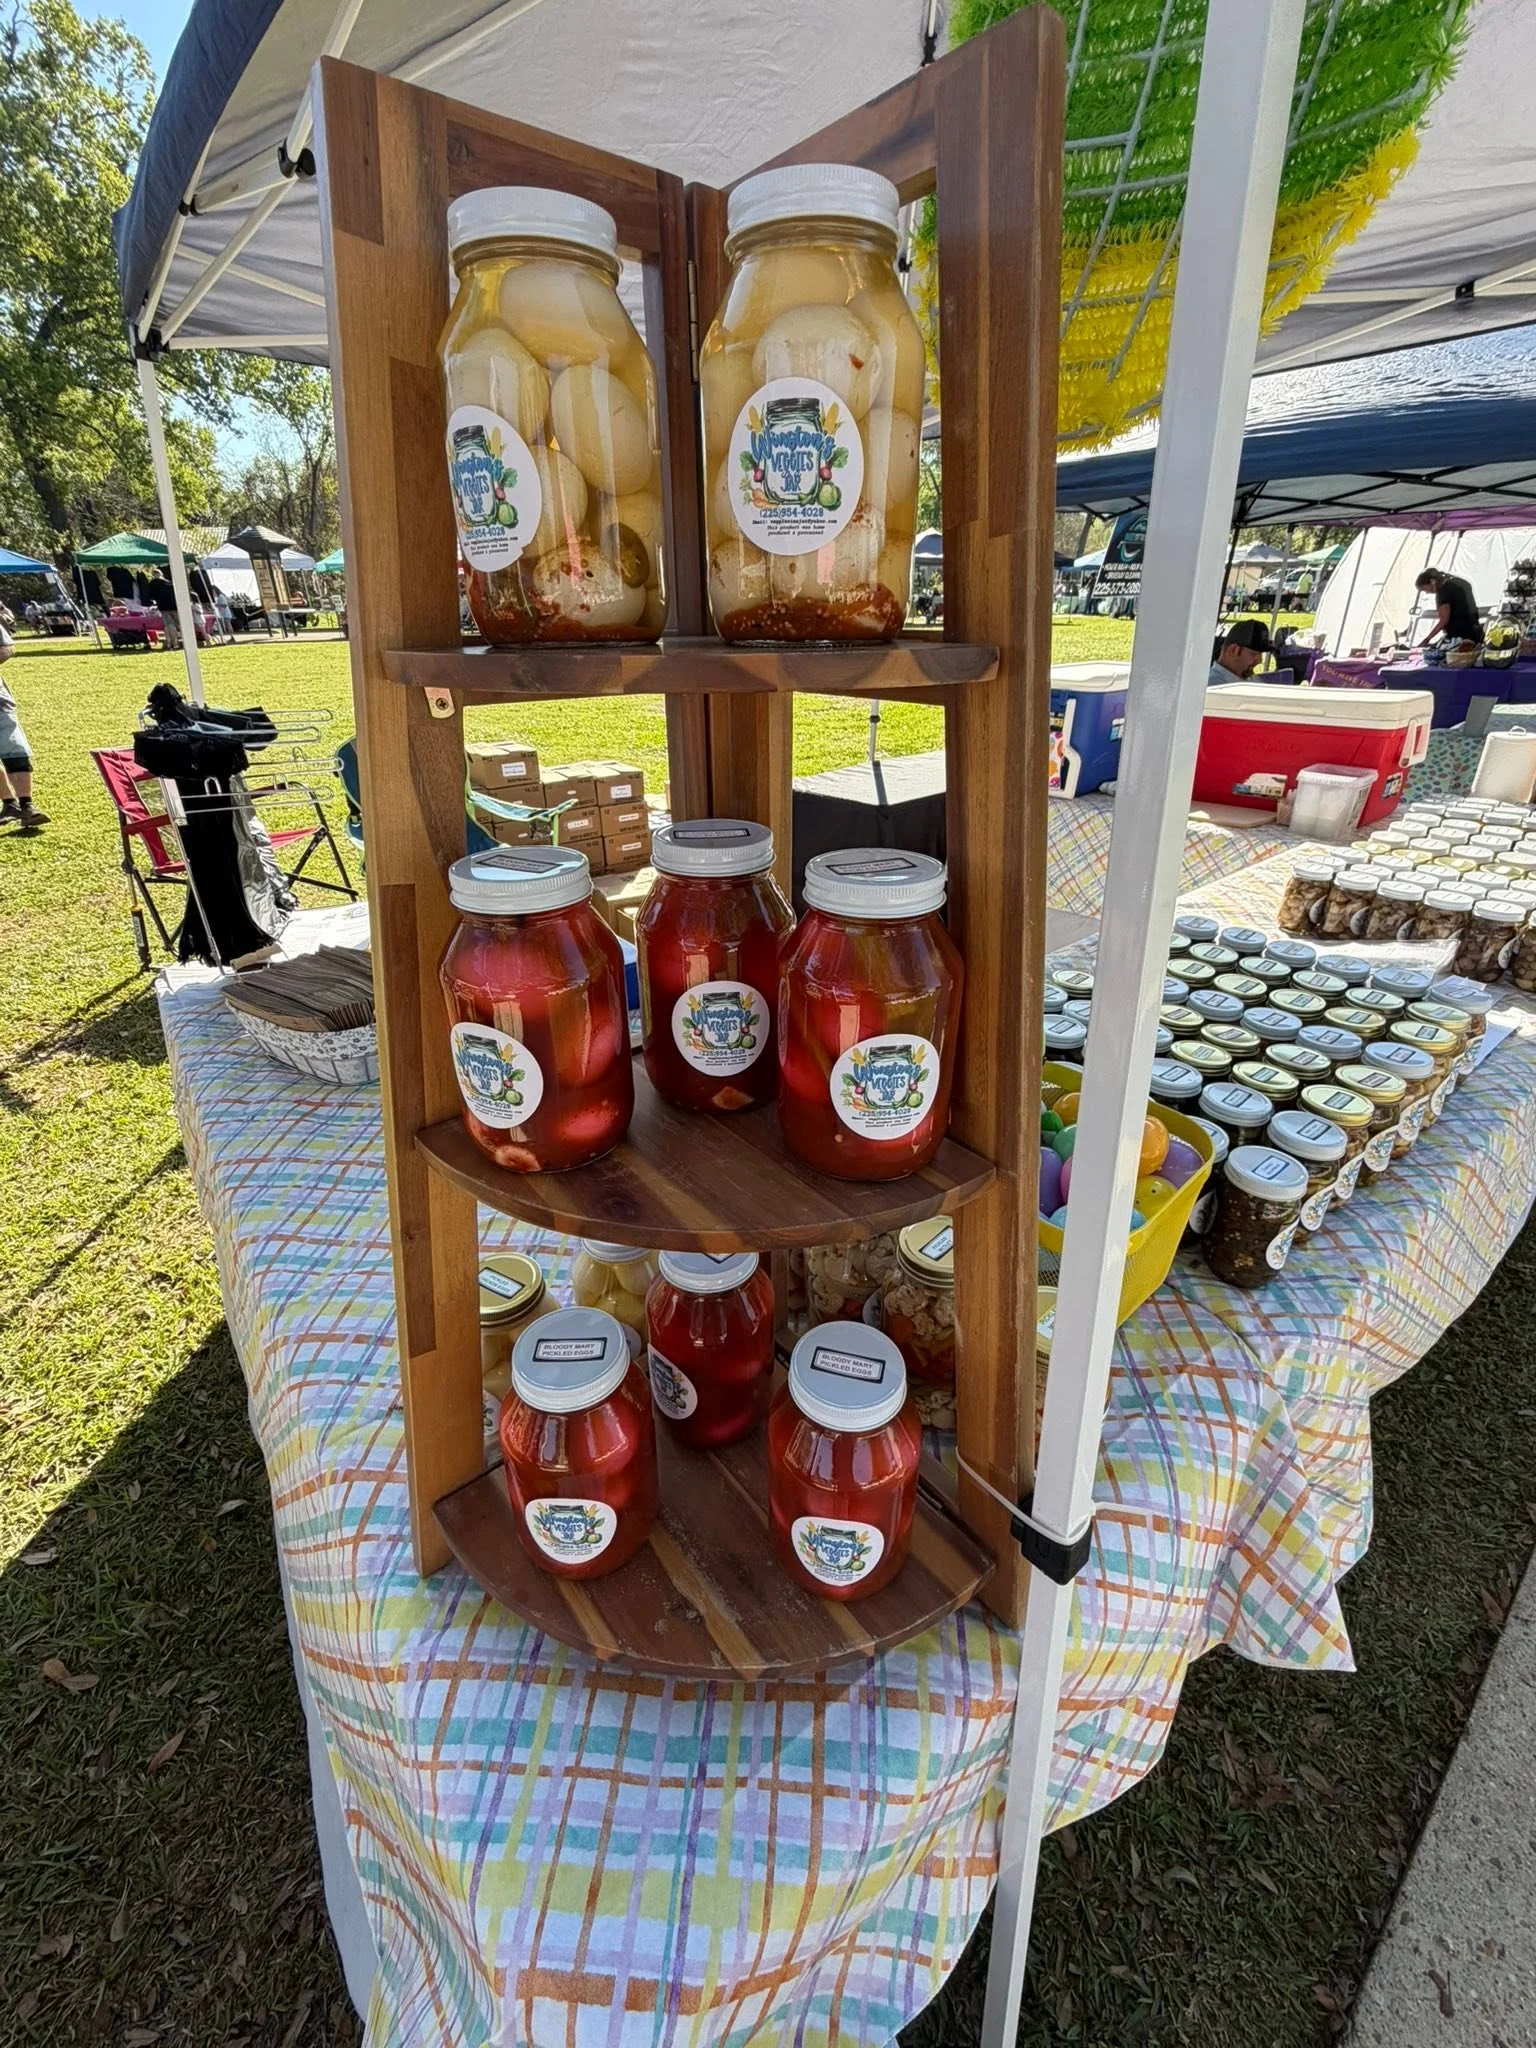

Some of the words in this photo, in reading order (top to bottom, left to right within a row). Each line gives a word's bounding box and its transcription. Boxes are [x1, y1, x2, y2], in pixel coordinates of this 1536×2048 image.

[751, 425, 836, 460] Winston's
[771, 451, 814, 472] VEGGIES
[780, 474, 802, 492] JAR
[760, 507, 824, 519] (225)954-4028
[820, 1360, 850, 1372] PICKLED
[852, 1367, 872, 1376] EGGS
[822, 1354, 852, 1364] BLOODY
[852, 1360, 874, 1369] MARY
